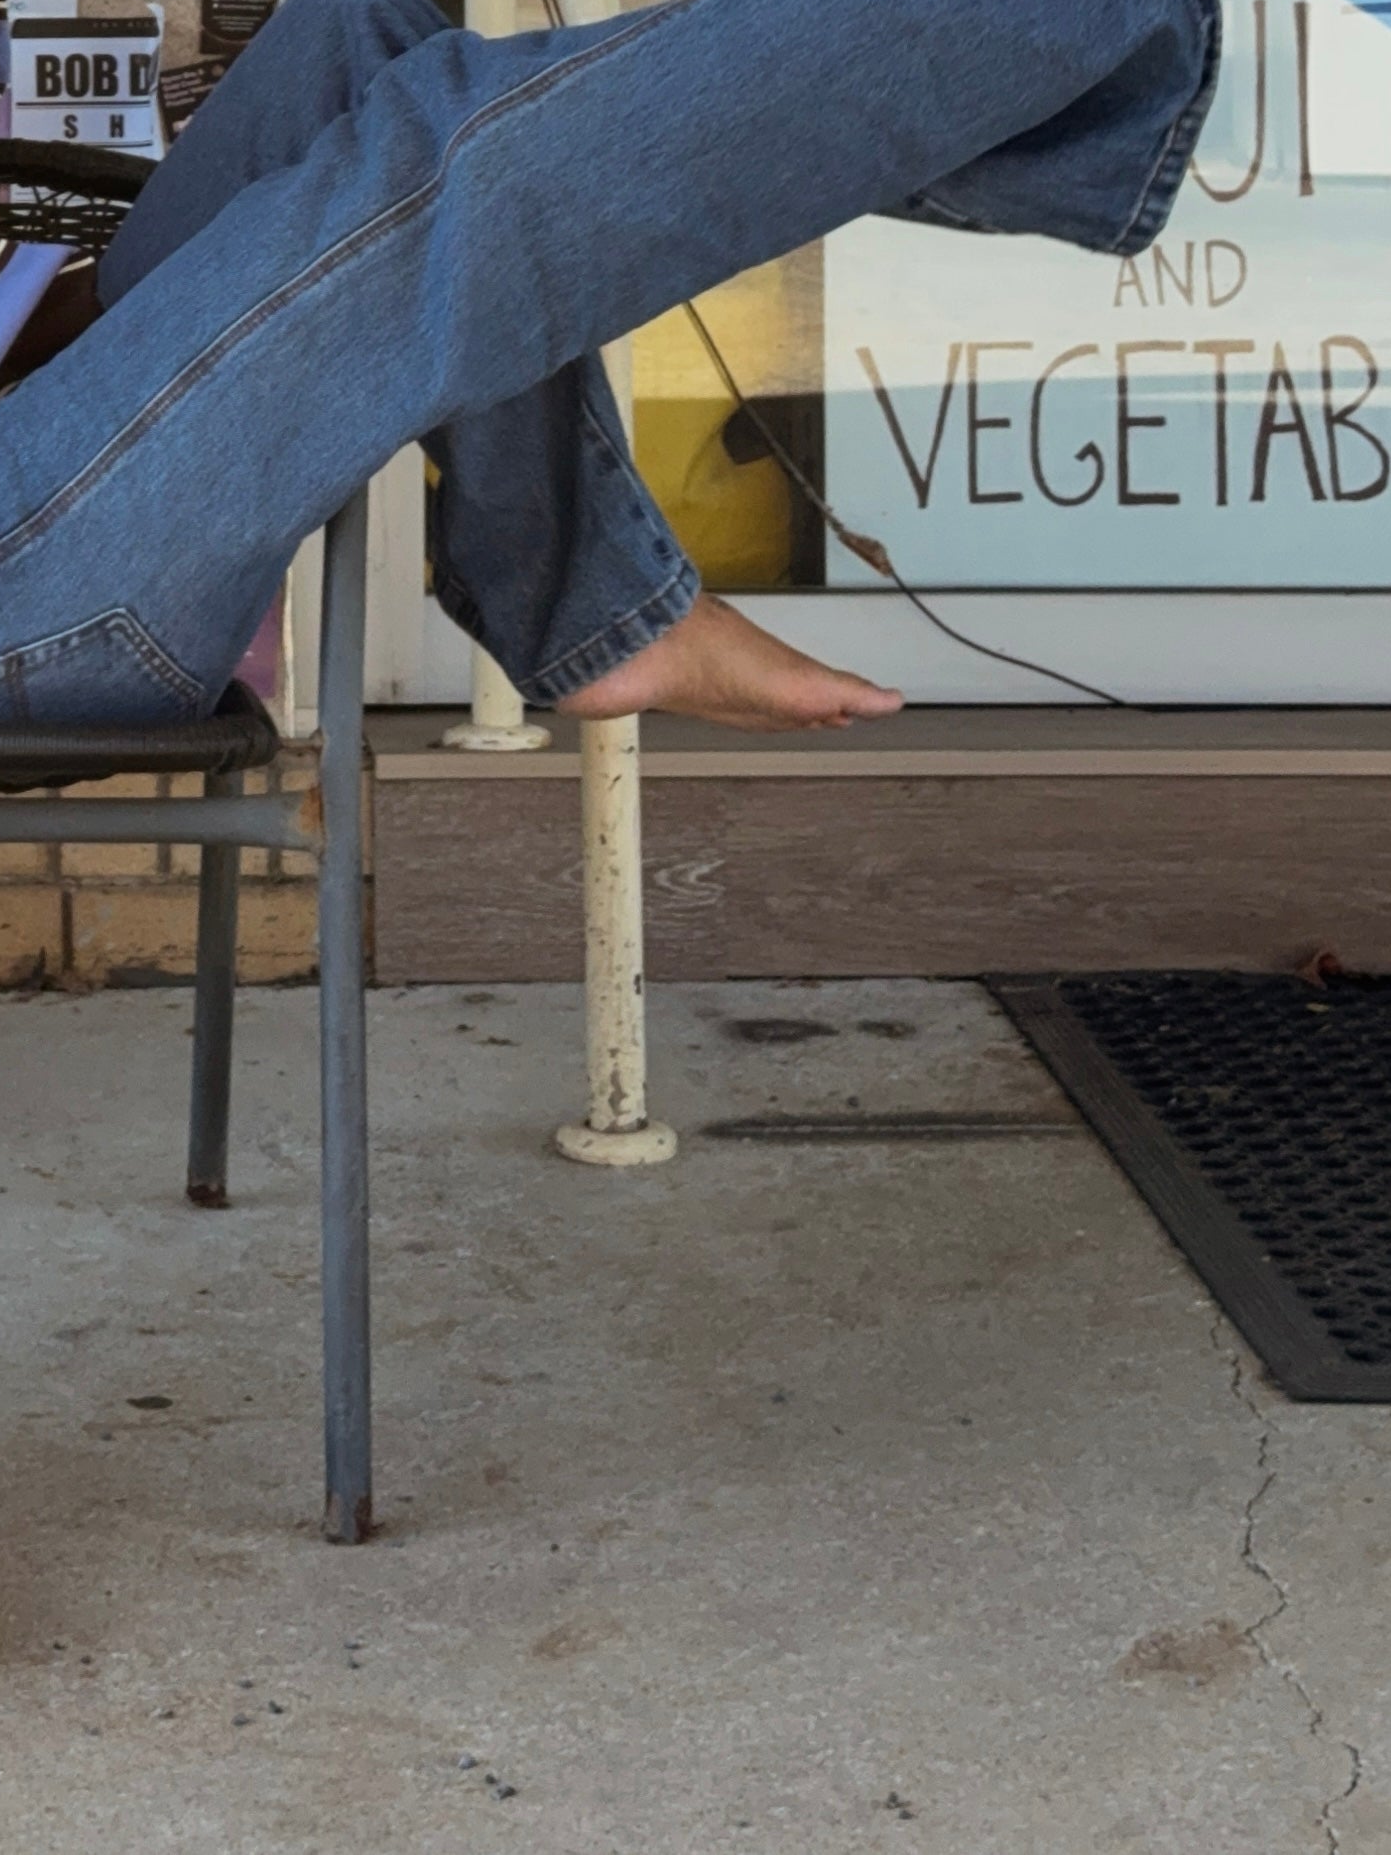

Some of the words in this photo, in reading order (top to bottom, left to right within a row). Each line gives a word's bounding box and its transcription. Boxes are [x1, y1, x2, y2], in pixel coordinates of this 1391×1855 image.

[36, 53, 119, 98] BOB
[63, 114, 78, 139] S
[109, 114, 125, 139] H
[1113, 239, 1248, 309] AND
